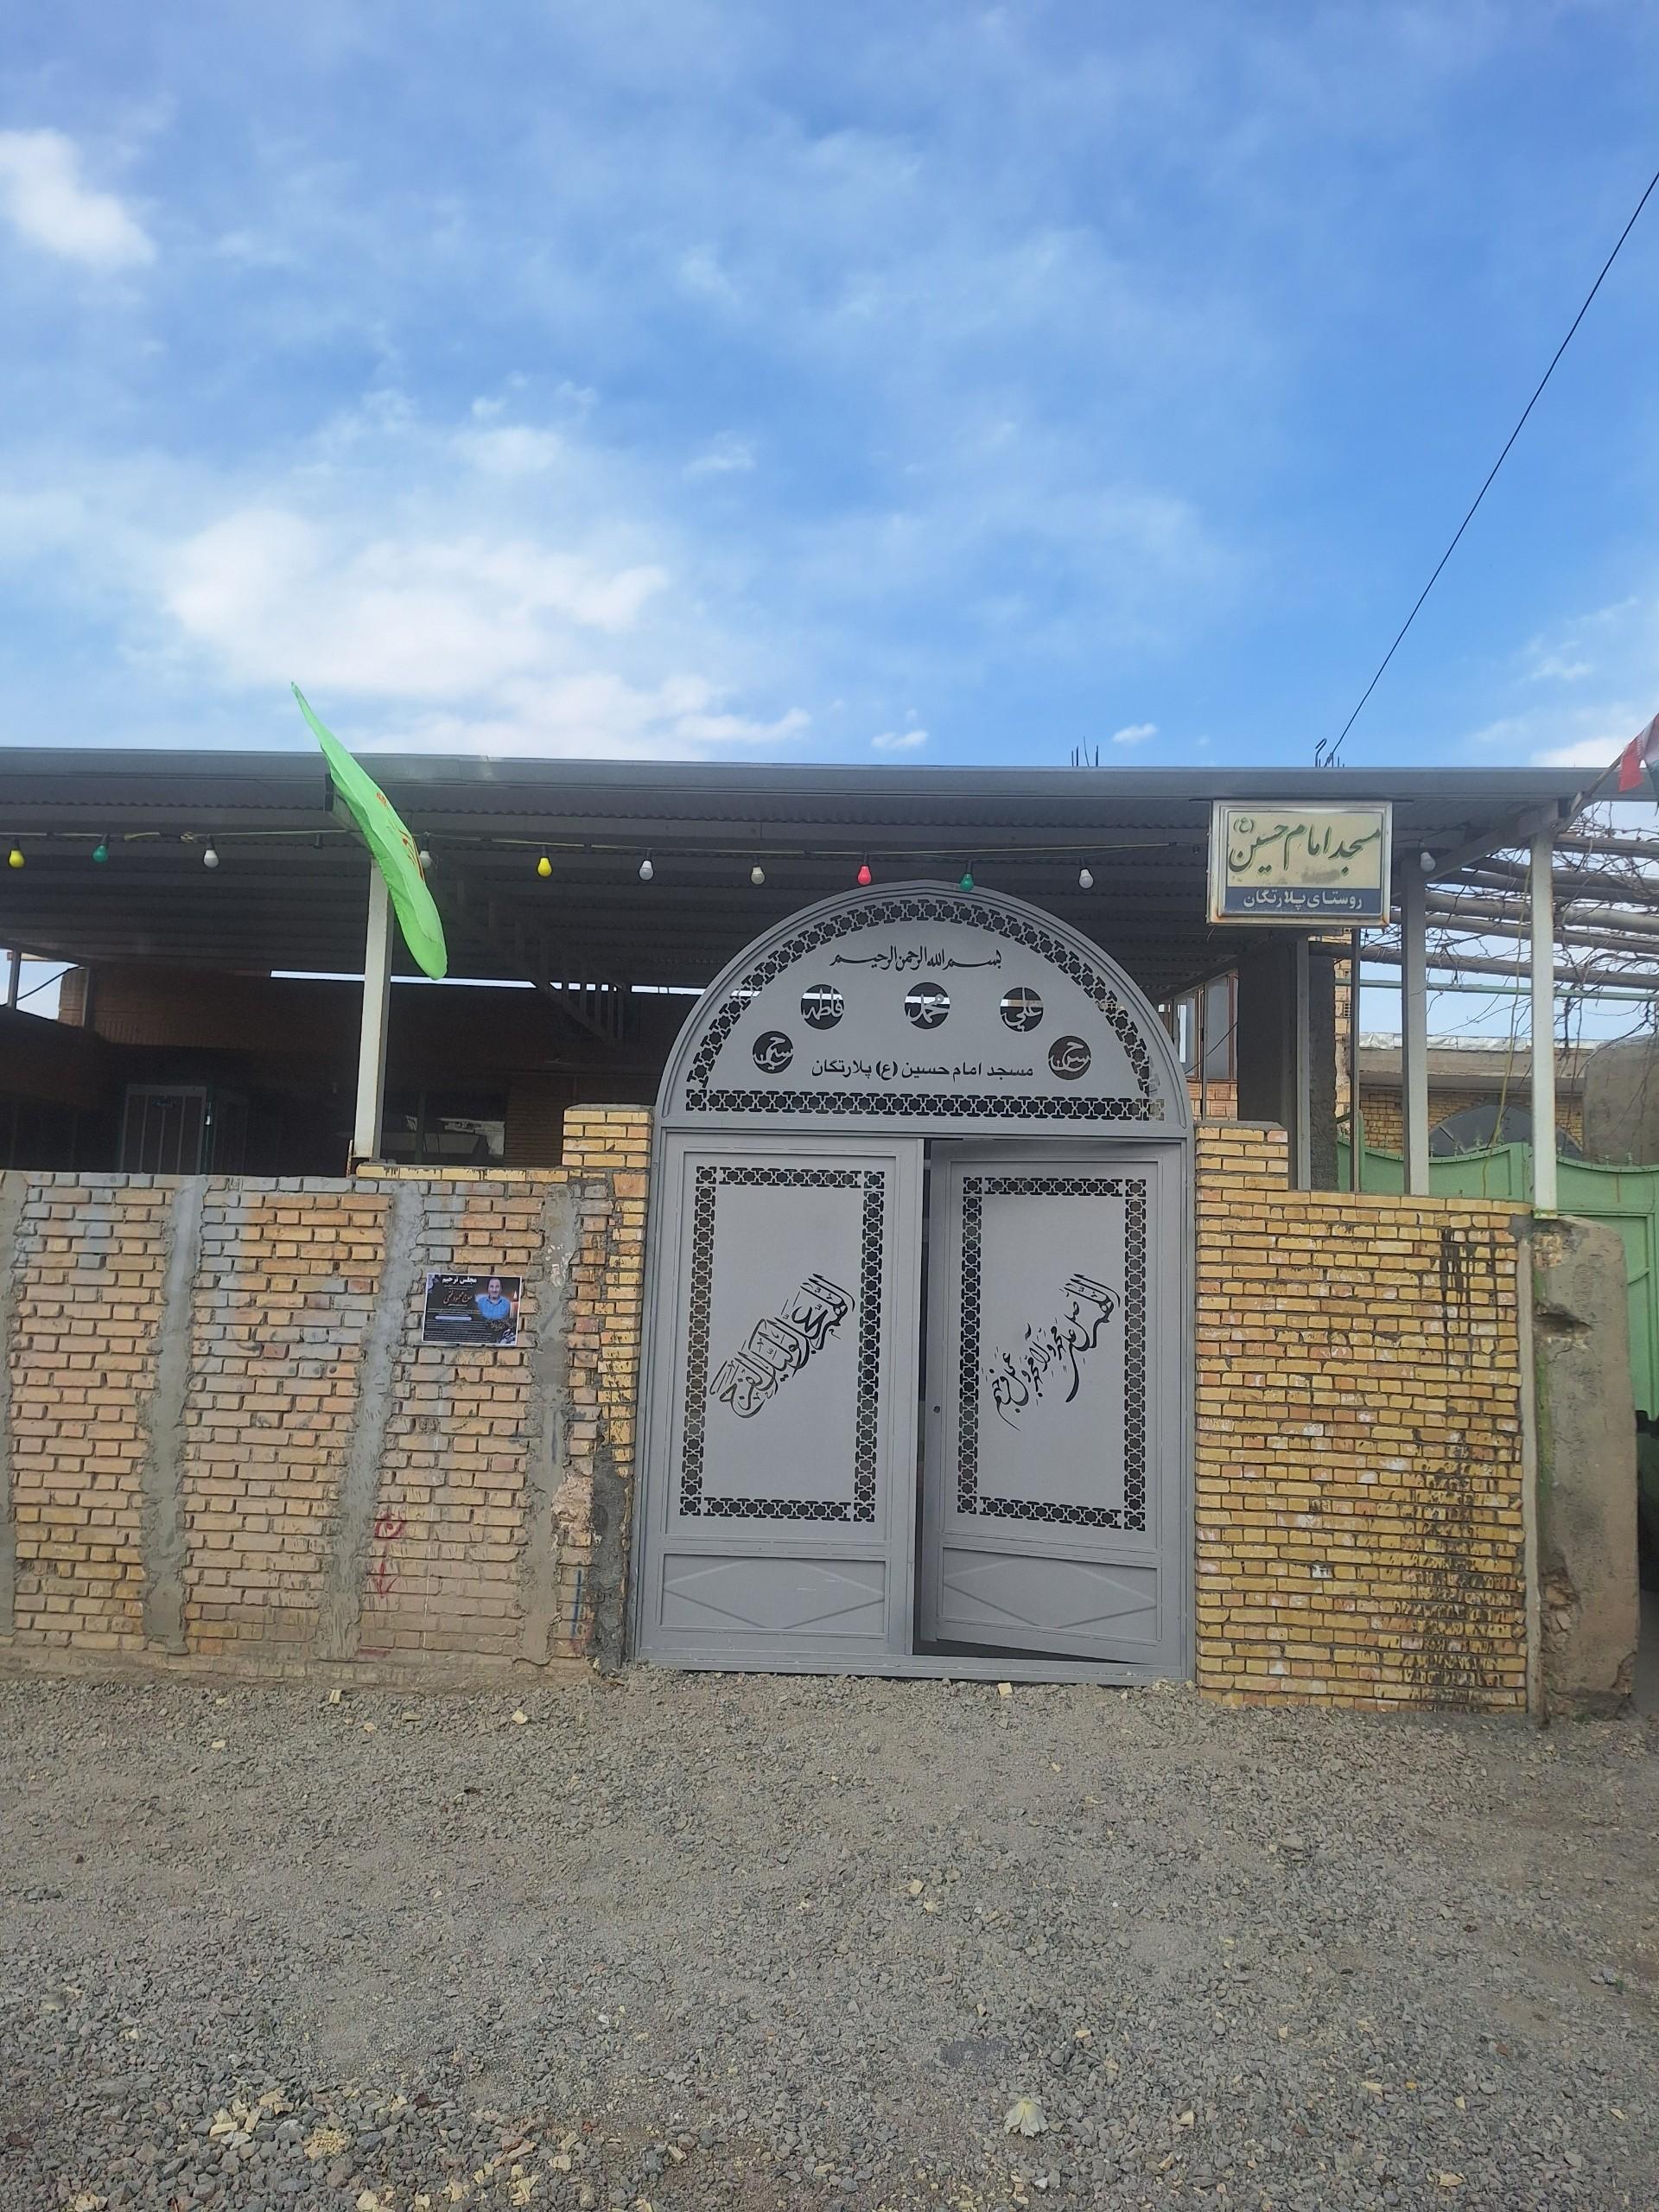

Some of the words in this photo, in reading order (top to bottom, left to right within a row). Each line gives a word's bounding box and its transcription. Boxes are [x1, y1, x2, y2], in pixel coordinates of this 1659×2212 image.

[1228, 823, 1290, 874] حسین
[1283, 823, 1333, 872] امام
[1328, 827, 1382, 876] مسجد
[1306, 890, 1363, 910] روستای
[895, 945, 928, 972] الرحمن
[926, 947, 945, 968] الله
[942, 949, 1002, 970] بسم
[906, 993, 950, 1025] محمد
[901, 1061, 950, 1078] حسین
[952, 1061, 982, 1083] امام
[987, 1064, 1034, 1080] مسجد
[442, 1276, 458, 1285] ترحیم
[459, 1276, 478, 1285] مجلس
